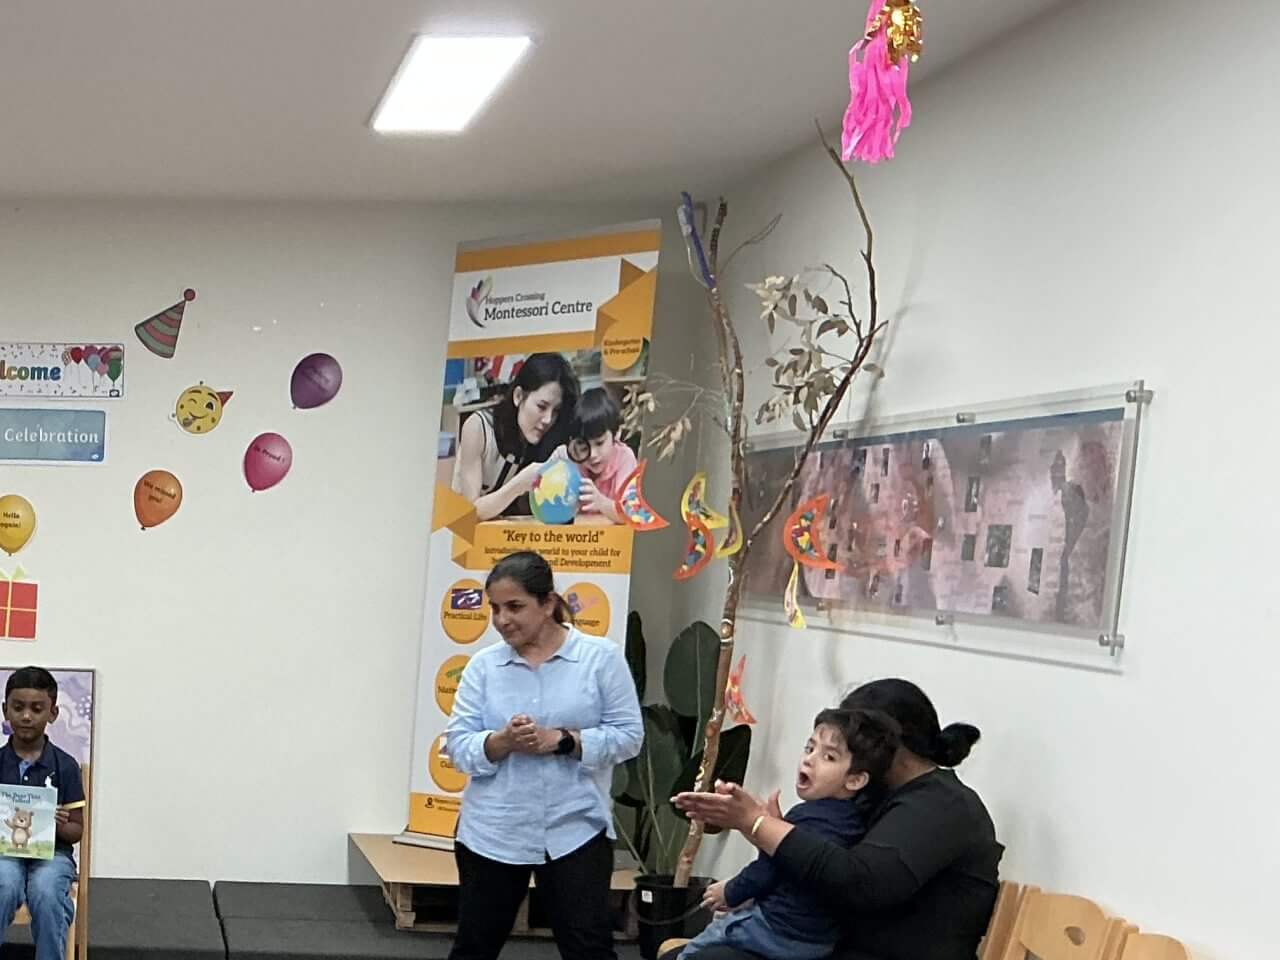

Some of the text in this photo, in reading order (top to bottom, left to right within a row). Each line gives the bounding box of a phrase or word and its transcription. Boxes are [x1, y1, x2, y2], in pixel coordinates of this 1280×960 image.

[483, 301, 593, 321] Montessori Centre
[4, 426, 100, 444] Celebration
[503, 528, 605, 544] "Key to the world"
[589, 548, 609, 557] child
[610, 549, 622, 558] for
[559, 558, 612, 569] Development
